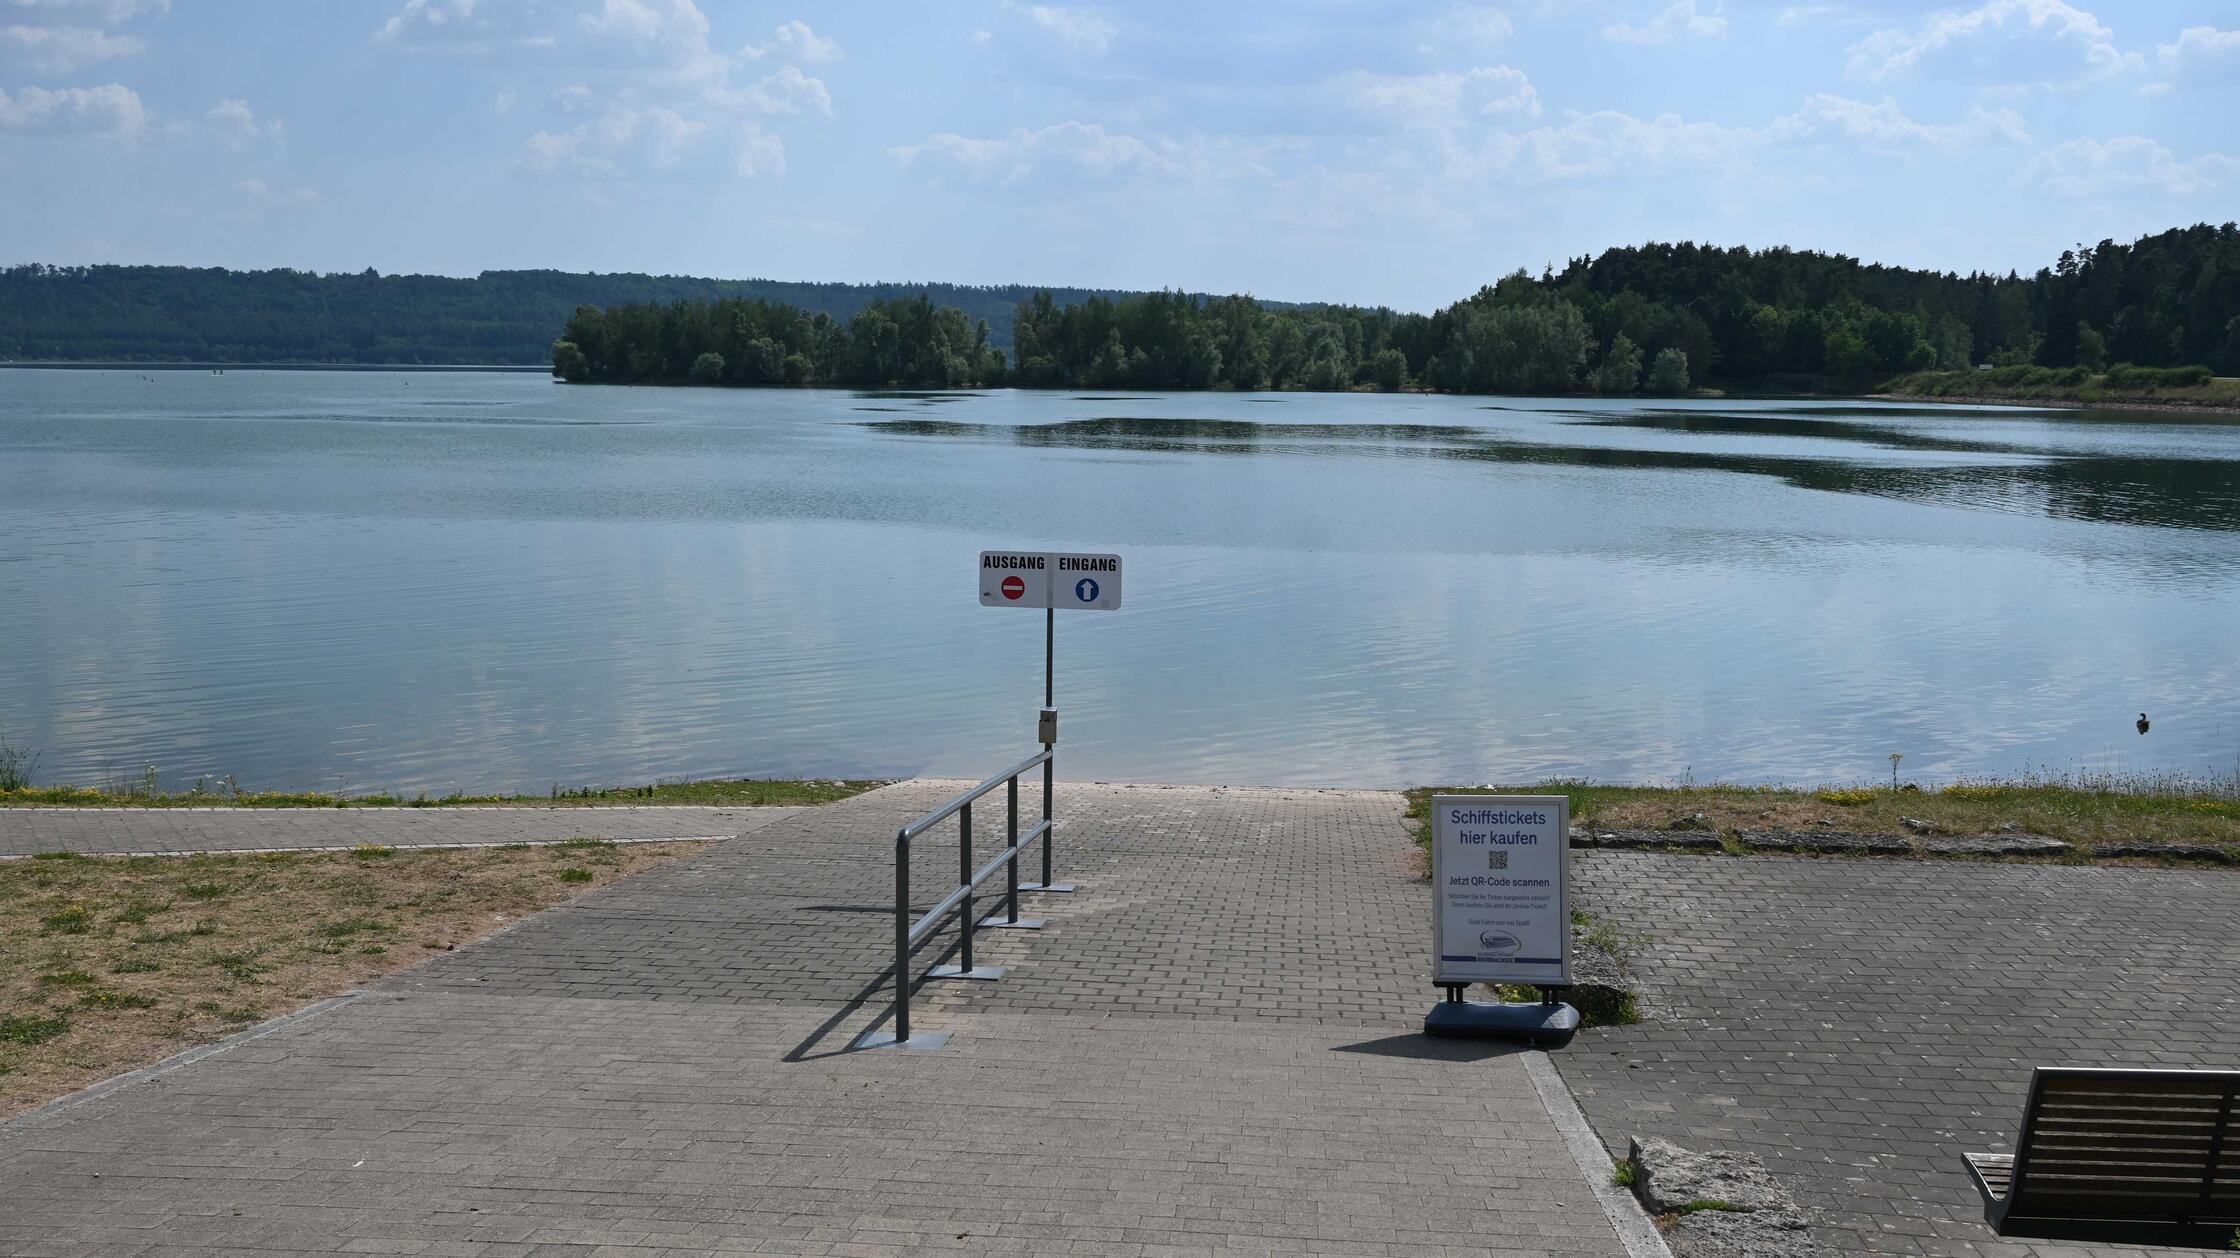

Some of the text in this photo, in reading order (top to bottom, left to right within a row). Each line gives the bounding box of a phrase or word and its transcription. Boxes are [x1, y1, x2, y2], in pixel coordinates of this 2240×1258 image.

[983, 555, 1045, 570] AUSGANG
[1059, 557, 1117, 572] EINGANG
[1451, 809, 1546, 825] Schiffstickets
[1460, 830, 1537, 845] hier kaufen
[1449, 876, 1550, 887] Jetzt QR-Code scannen
